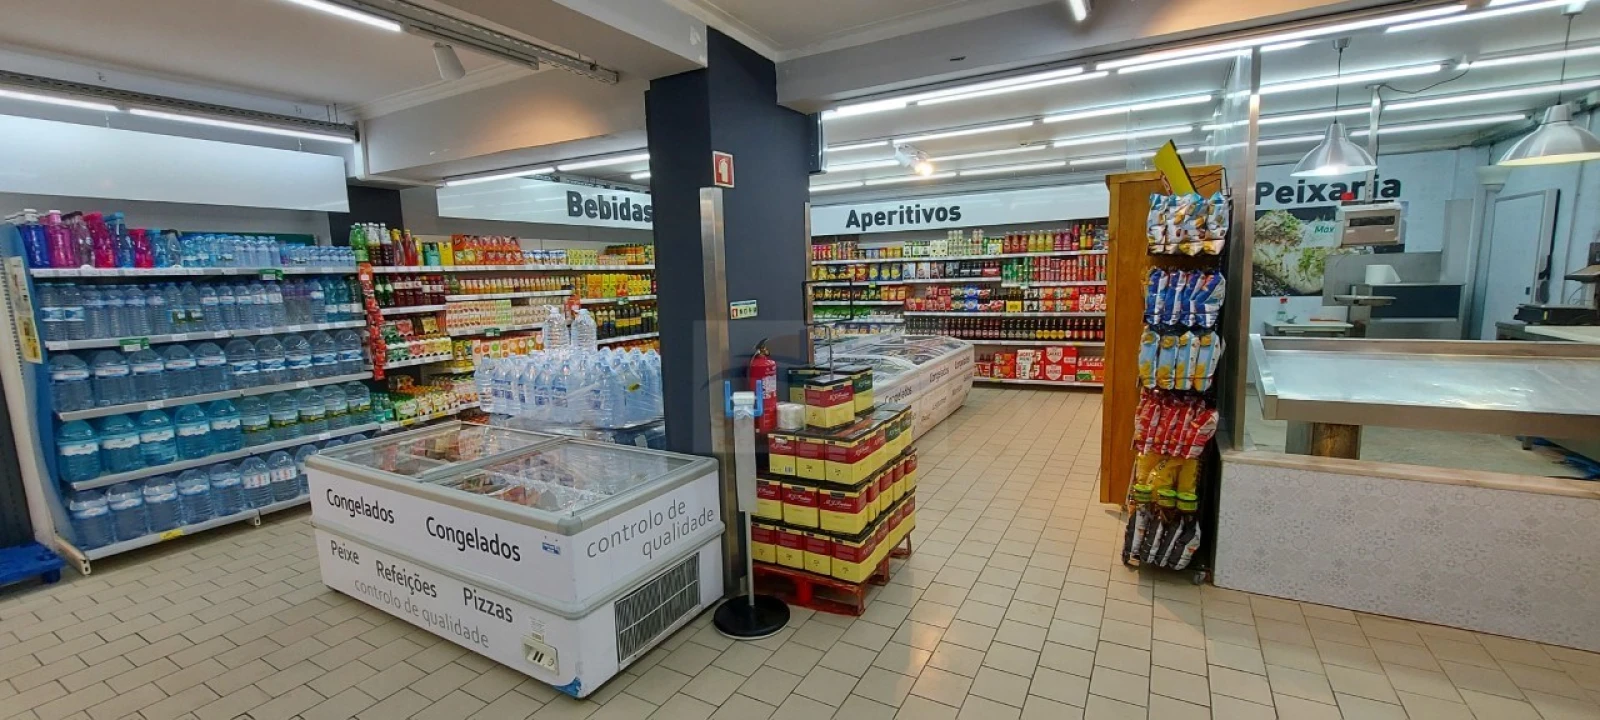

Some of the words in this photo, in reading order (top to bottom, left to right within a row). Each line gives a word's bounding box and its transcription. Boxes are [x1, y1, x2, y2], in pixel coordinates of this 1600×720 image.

[566, 190, 654, 223] Bebidas
[845, 203, 962, 232] Aperitivos
[1255, 174, 1401, 206] Peixaria
[326, 488, 395, 524] Congelados
[426, 516, 521, 561] Congelados
[586, 509, 664, 558] controlo
[668, 499, 686, 520] de
[642, 507, 714, 560] qualidade
[330, 540, 360, 565] Peixe
[376, 559, 437, 598] Refeições
[463, 587, 513, 623] Pizzas
[354, 579, 401, 610] controlo
[404, 597, 420, 617] de
[422, 608, 490, 648] qualidade
